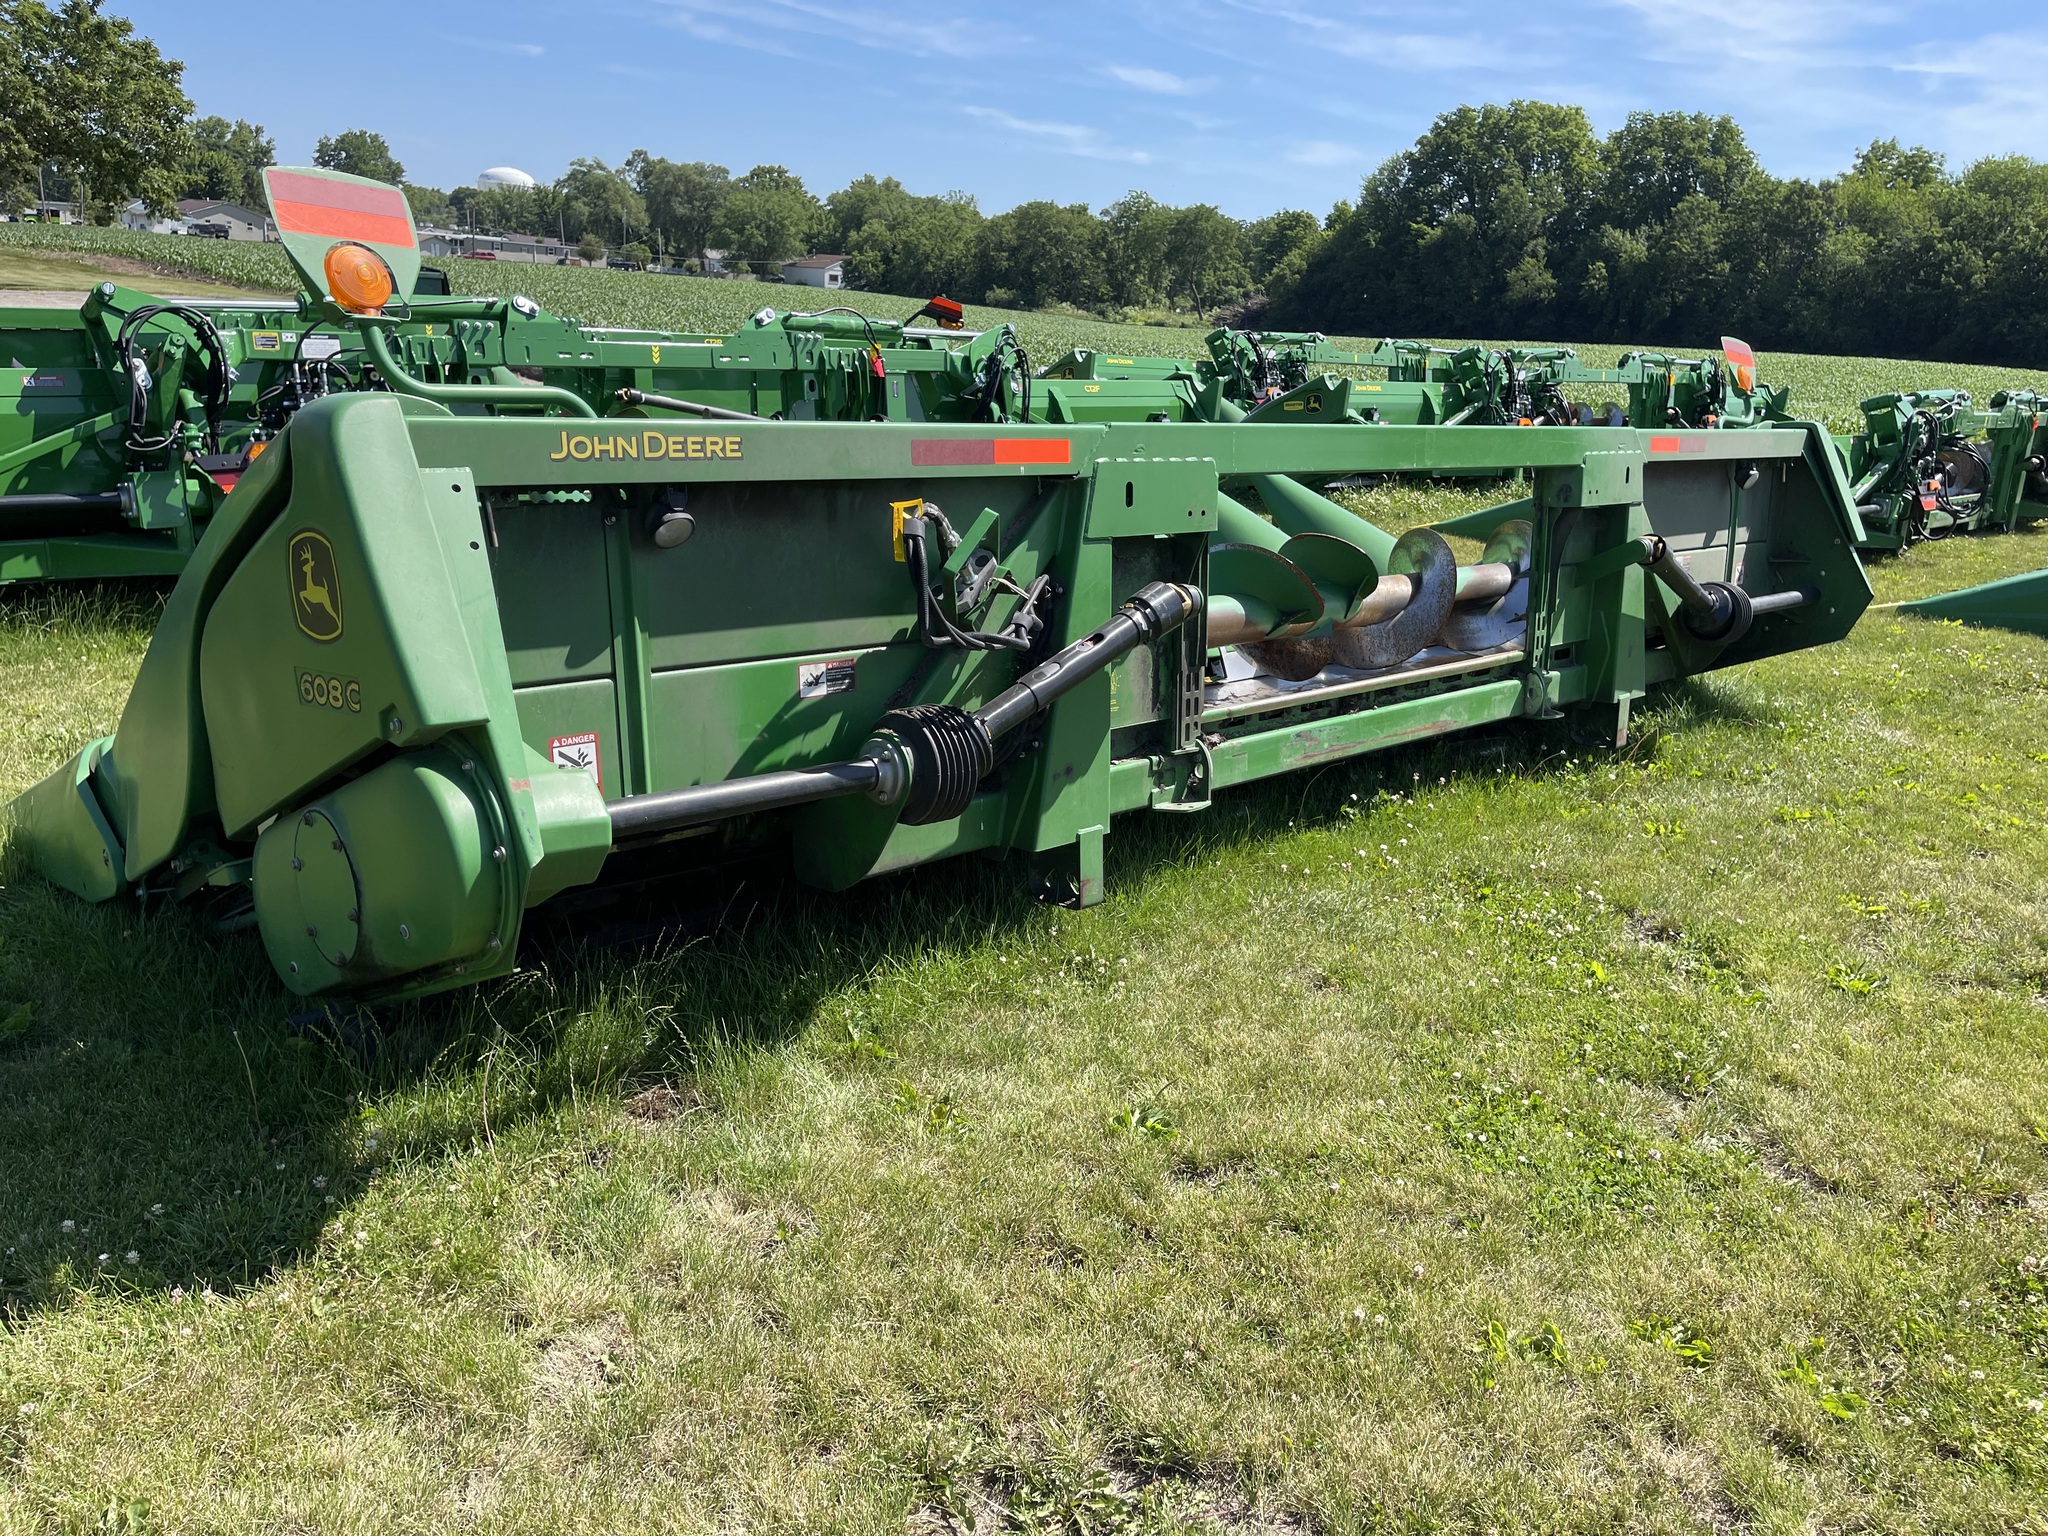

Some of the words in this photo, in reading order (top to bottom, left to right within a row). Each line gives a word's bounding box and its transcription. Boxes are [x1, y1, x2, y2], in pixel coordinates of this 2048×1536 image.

[550, 430, 640, 461] JOHN
[642, 430, 744, 461] DEERE
[299, 671, 362, 714] 608C
[561, 734, 596, 746] DANGER
